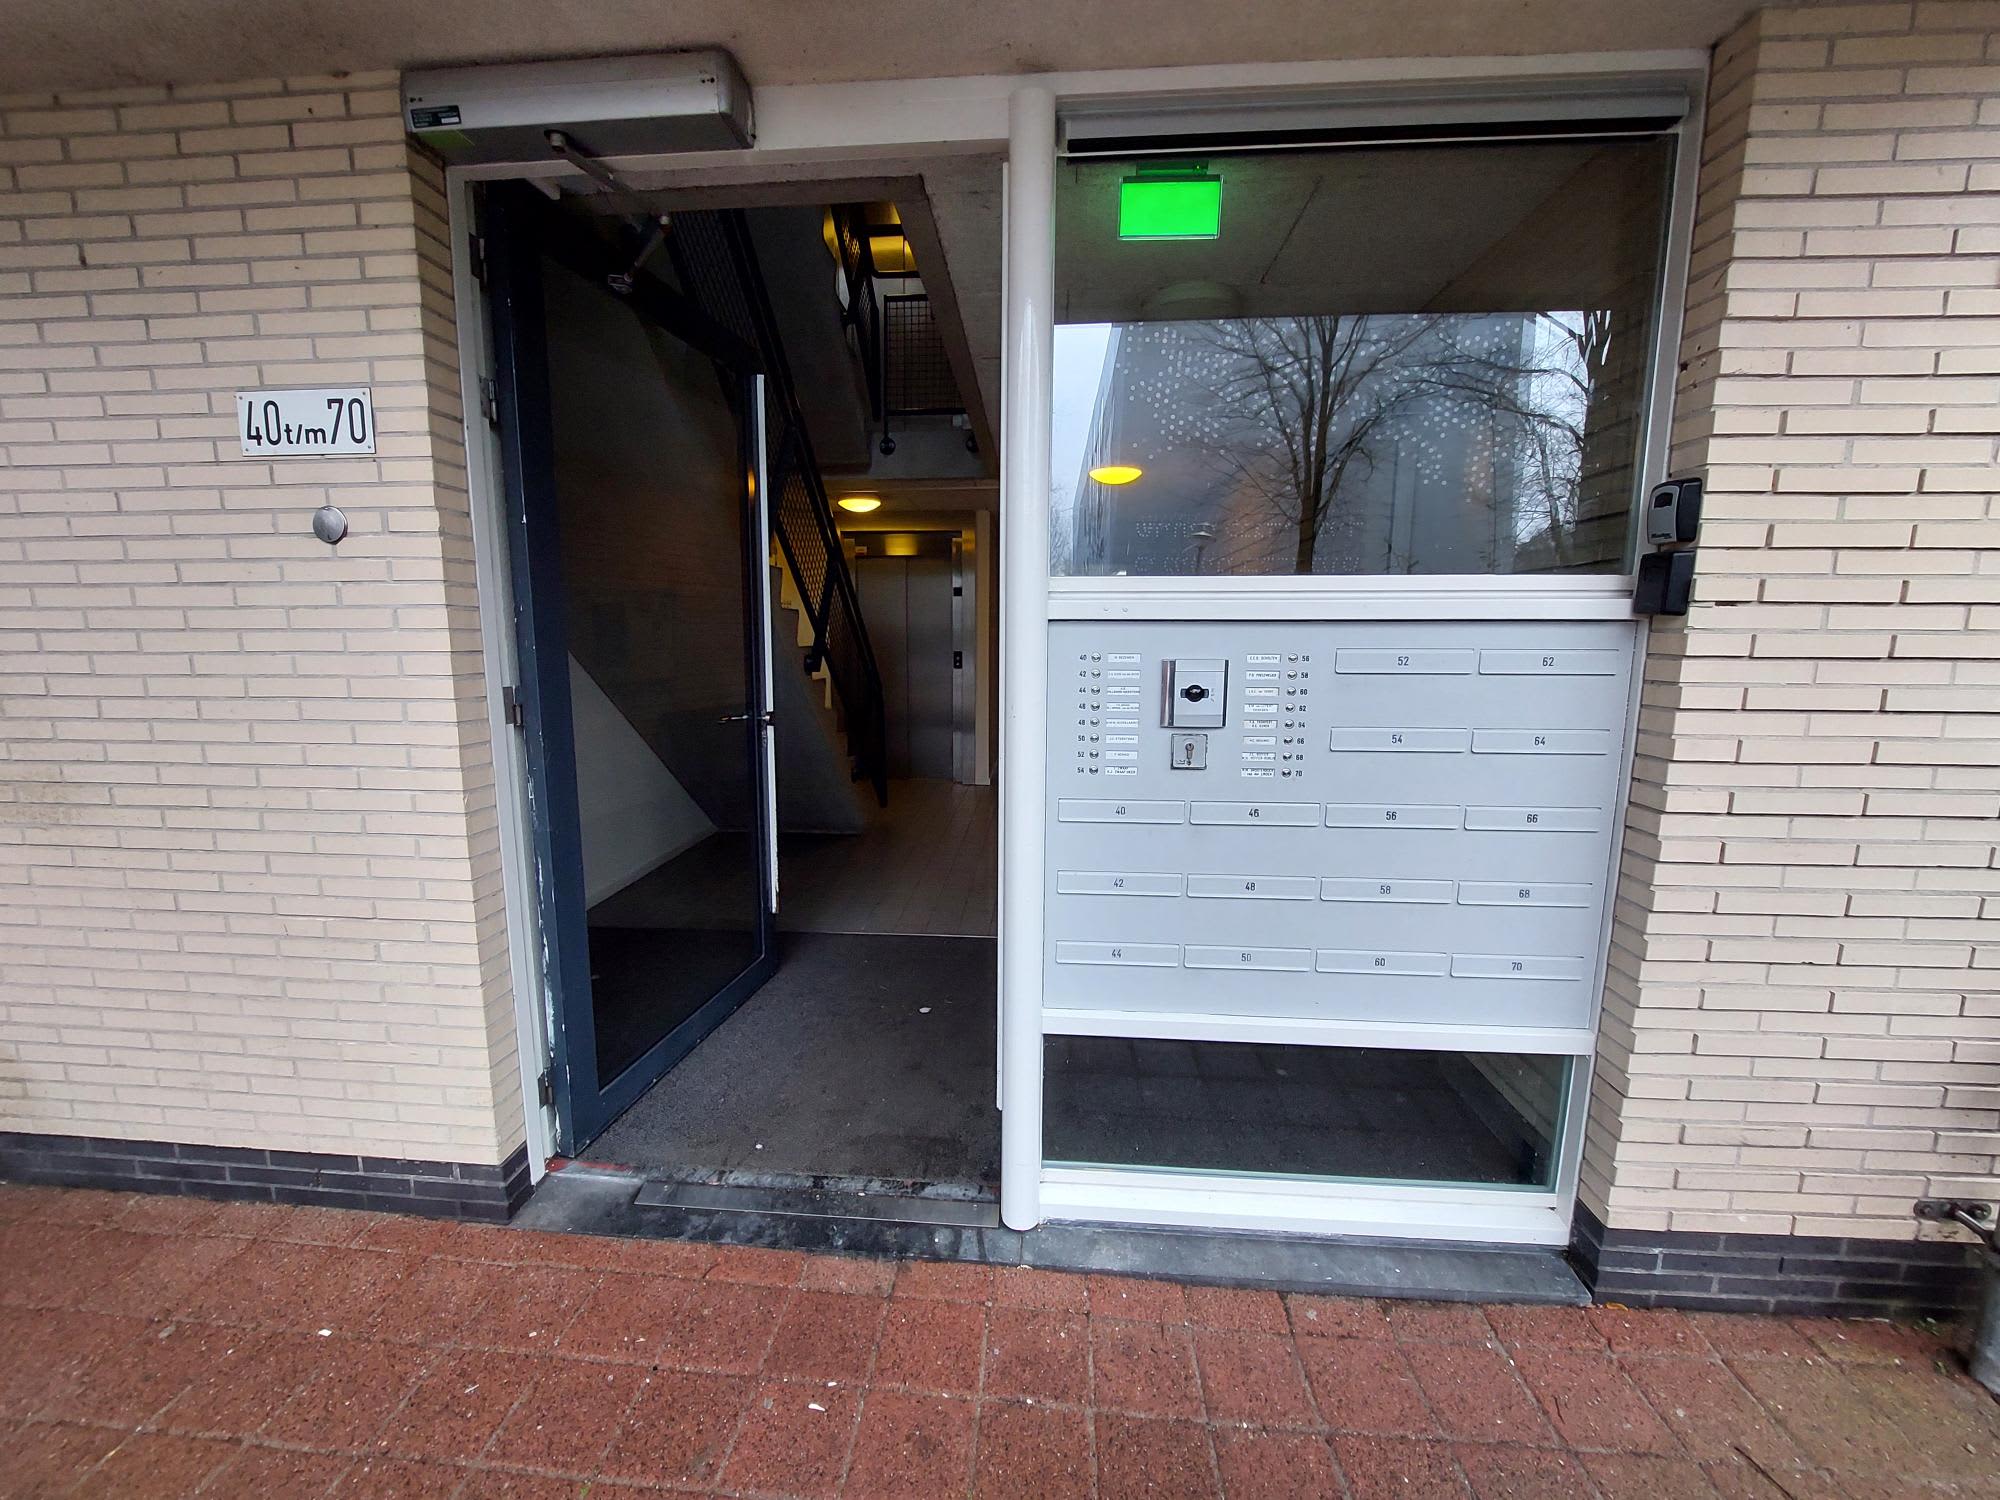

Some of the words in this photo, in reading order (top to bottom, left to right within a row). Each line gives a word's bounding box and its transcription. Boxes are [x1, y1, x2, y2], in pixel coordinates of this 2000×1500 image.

[1398, 656, 1409, 666] 52
[1543, 656, 1554, 666] 62
[1392, 733, 1402, 744] 54
[1535, 736, 1545, 745] 64
[1115, 806, 1125, 815] 40
[1249, 808, 1259, 817] 46
[1386, 811, 1397, 820] 56
[1527, 814, 1538, 823] 66
[1114, 878, 1124, 887] 42
[1245, 882, 1255, 891] 48
[1380, 885, 1391, 894] 58
[1519, 889, 1530, 898] 68
[1112, 949, 1121, 958] 44
[1241, 953, 1251, 962] 50
[1375, 957, 1385, 966] 60
[1512, 962, 1522, 971] 70
